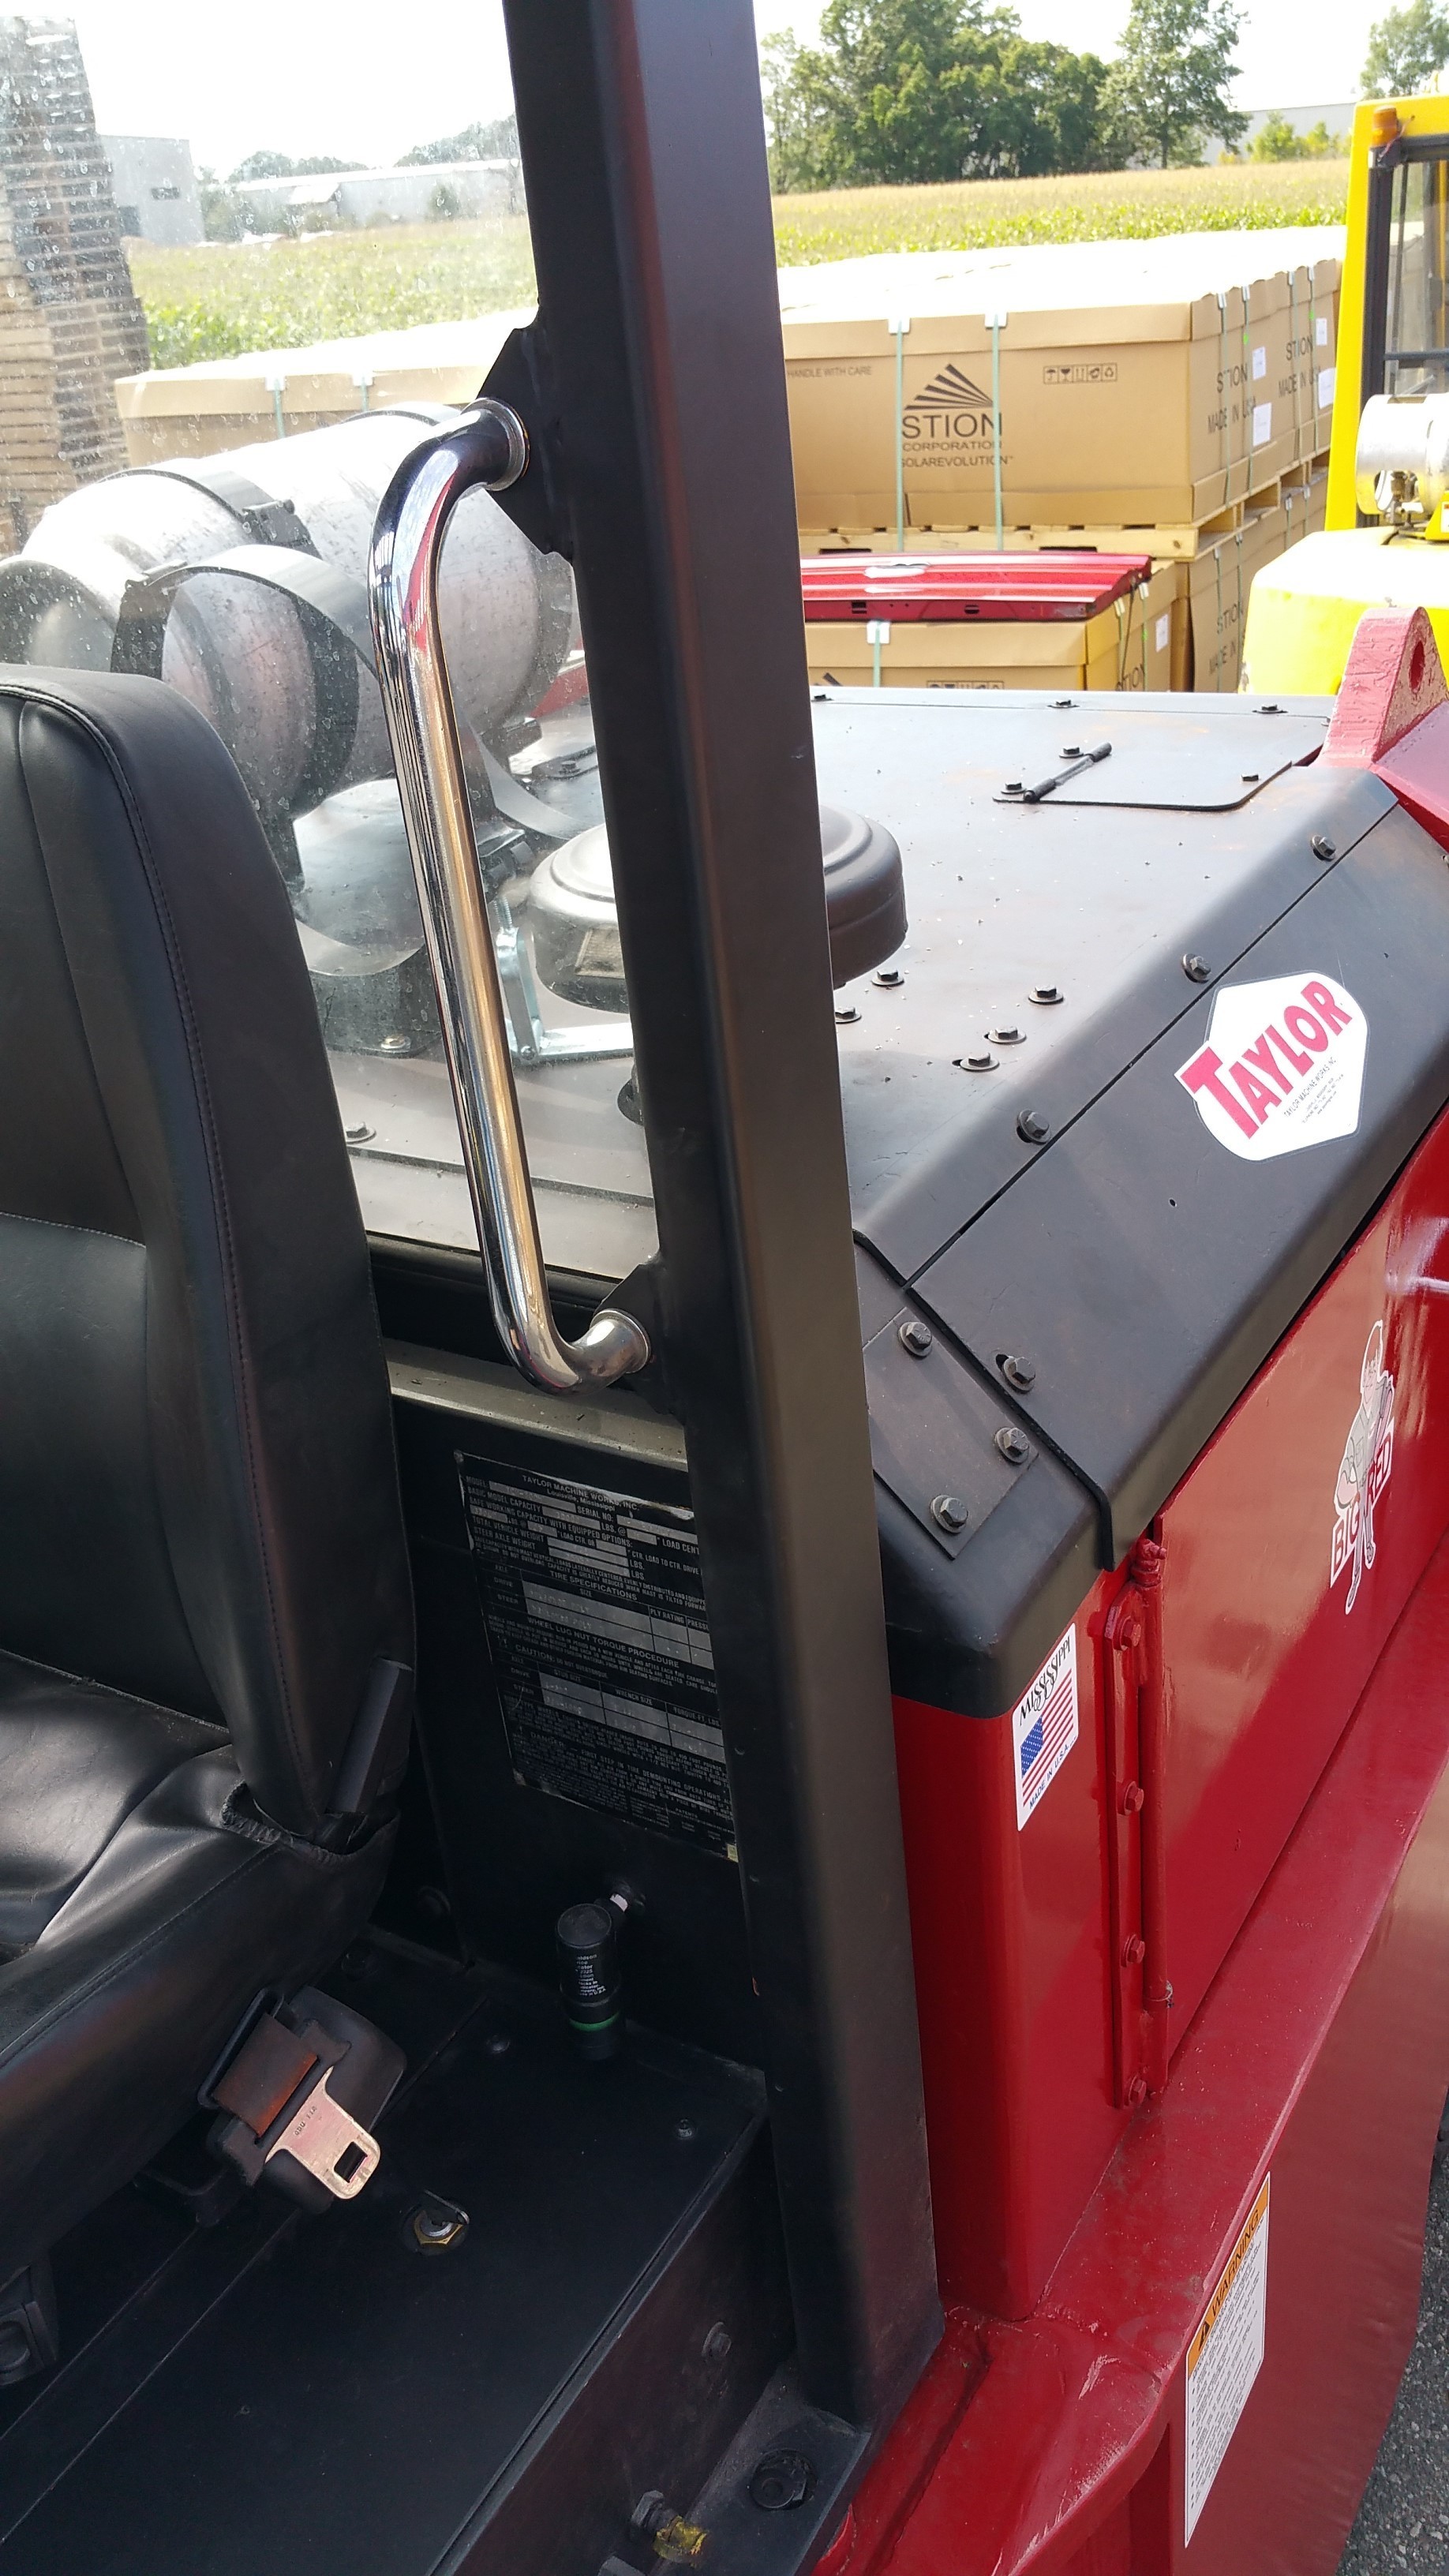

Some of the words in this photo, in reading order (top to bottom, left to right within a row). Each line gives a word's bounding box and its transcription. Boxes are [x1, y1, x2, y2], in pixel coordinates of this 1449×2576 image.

[1286, 335, 1313, 361] STION
[824, 366, 847, 377] WITH
[848, 365, 871, 376] CARE
[1279, 374, 1297, 397] MADE
[902, 412, 1002, 439] STION
[1208, 407, 1227, 434] MADE
[903, 440, 1002, 451] CORPORATION
[1180, 981, 1353, 1139] TAYLOR
[1283, 1099, 1301, 1118] TAYLOR
[1297, 1079, 1317, 1101] MACHINE
[1313, 1064, 1330, 1081] WORKS
[522, 1474, 552, 1488] TAYLOR
[554, 1482, 588, 1499] MACHINE
[622, 1500, 638, 1511] INC.
[546, 1488, 578, 1503] Louisville,
[579, 1496, 616, 1513] Mississippi
[1334, 1497, 1360, 1571] BIG
[1367, 1433, 1391, 1513] RED
[467, 1485, 486, 1498] BASIC
[487, 1491, 508, 1504] MODEL
[509, 1496, 541, 1513] CAPACITY
[601, 1522, 616, 1533] LBS.
[616, 1526, 626, 1535] @
[661, 1537, 680, 1550] LOAD
[469, 1496, 485, 1507] SAFE
[485, 1500, 515, 1516] WORKING
[515, 1508, 548, 1525] CAPACITY
[549, 1518, 566, 1530] WITH
[567, 1522, 601, 1540] EQUIPPED
[601, 1532, 633, 1548] OPTIONS:
[576, 1505, 600, 1518] SERIAL
[601, 1511, 613, 1522] NO:
[472, 1515, 491, 1527] TOTAL
[492, 1521, 519, 1535] VEHICLE
[519, 1528, 545, 1543] WEIGHT
[628, 1558, 645, 1571] LBS.
[474, 1526, 493, 1538] STEER
[494, 1531, 510, 1543] AXLE
[511, 1536, 536, 1550] WEIGHT
[586, 1537, 595, 1547] OR
[644, 1553, 660, 1564] LOAD
[661, 1558, 668, 1567] TO
[682, 1563, 699, 1575] DRIVE
[549, 1570, 567, 1582] TIRE
[569, 1574, 638, 1601] SPECIFICATIONS
[601, 1576, 623, 1589] REDUCED
[625, 1582, 640, 1593] WHEN
[641, 1587, 656, 1597] MAST
[665, 1594, 683, 1604] TILTED
[623, 1577, 642, 1588] EVENLY
[579, 1588, 593, 1597] SIZE
[650, 1608, 661, 1617] PLY
[661, 1611, 684, 1623] RATING
[526, 1616, 554, 1631] WHEEL
[556, 1625, 572, 1636] LUG
[573, 1630, 590, 1641] NUT
[592, 1635, 627, 1653] TORQUE
[627, 1646, 680, 1668] PROCEDURE
[615, 1688, 639, 1701] WRENCH
[639, 1695, 653, 1705] SIZE
[1019, 1636, 1071, 1727] MISSISSIPPI
[599, 1754, 614, 1765] STEP
[627, 1764, 640, 1774] TIRE
[642, 1769, 682, 1788] DEMOUNTING
[683, 1783, 721, 1801] OPERATIONS
[1029, 1780, 1046, 1809] MADE
[1046, 1769, 1053, 1782] IN
[1054, 1744, 1069, 1769] U.S.A.
[1211, 2209, 1260, 2319] WARNING
